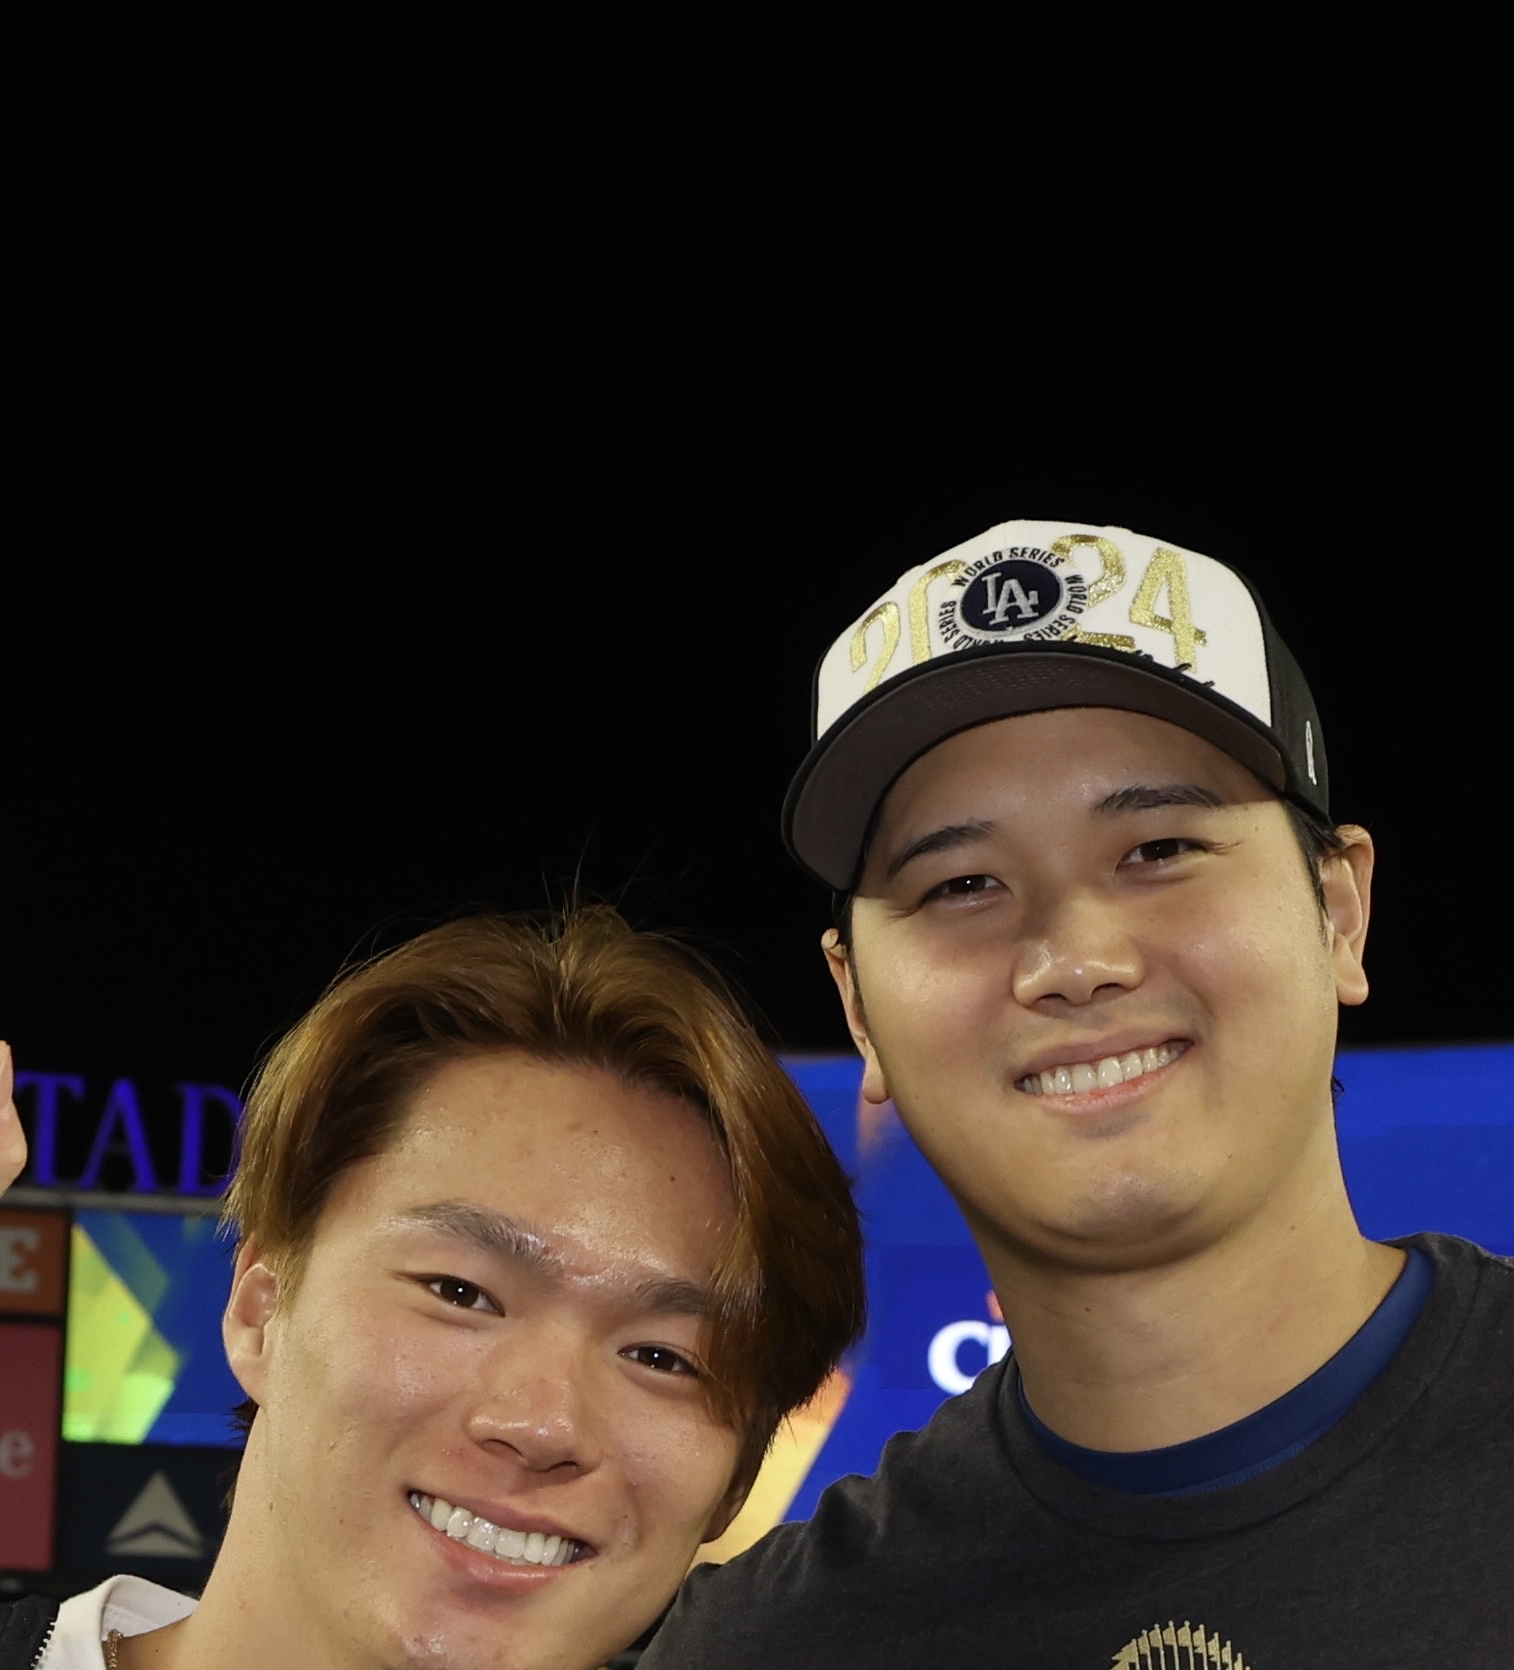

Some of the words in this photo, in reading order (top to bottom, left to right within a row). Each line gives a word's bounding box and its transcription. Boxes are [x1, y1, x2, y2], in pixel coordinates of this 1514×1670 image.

[951, 550, 1004, 588] WORLD
[1008, 547, 1066, 569] SERIES
[981, 572, 1039, 625] LA
